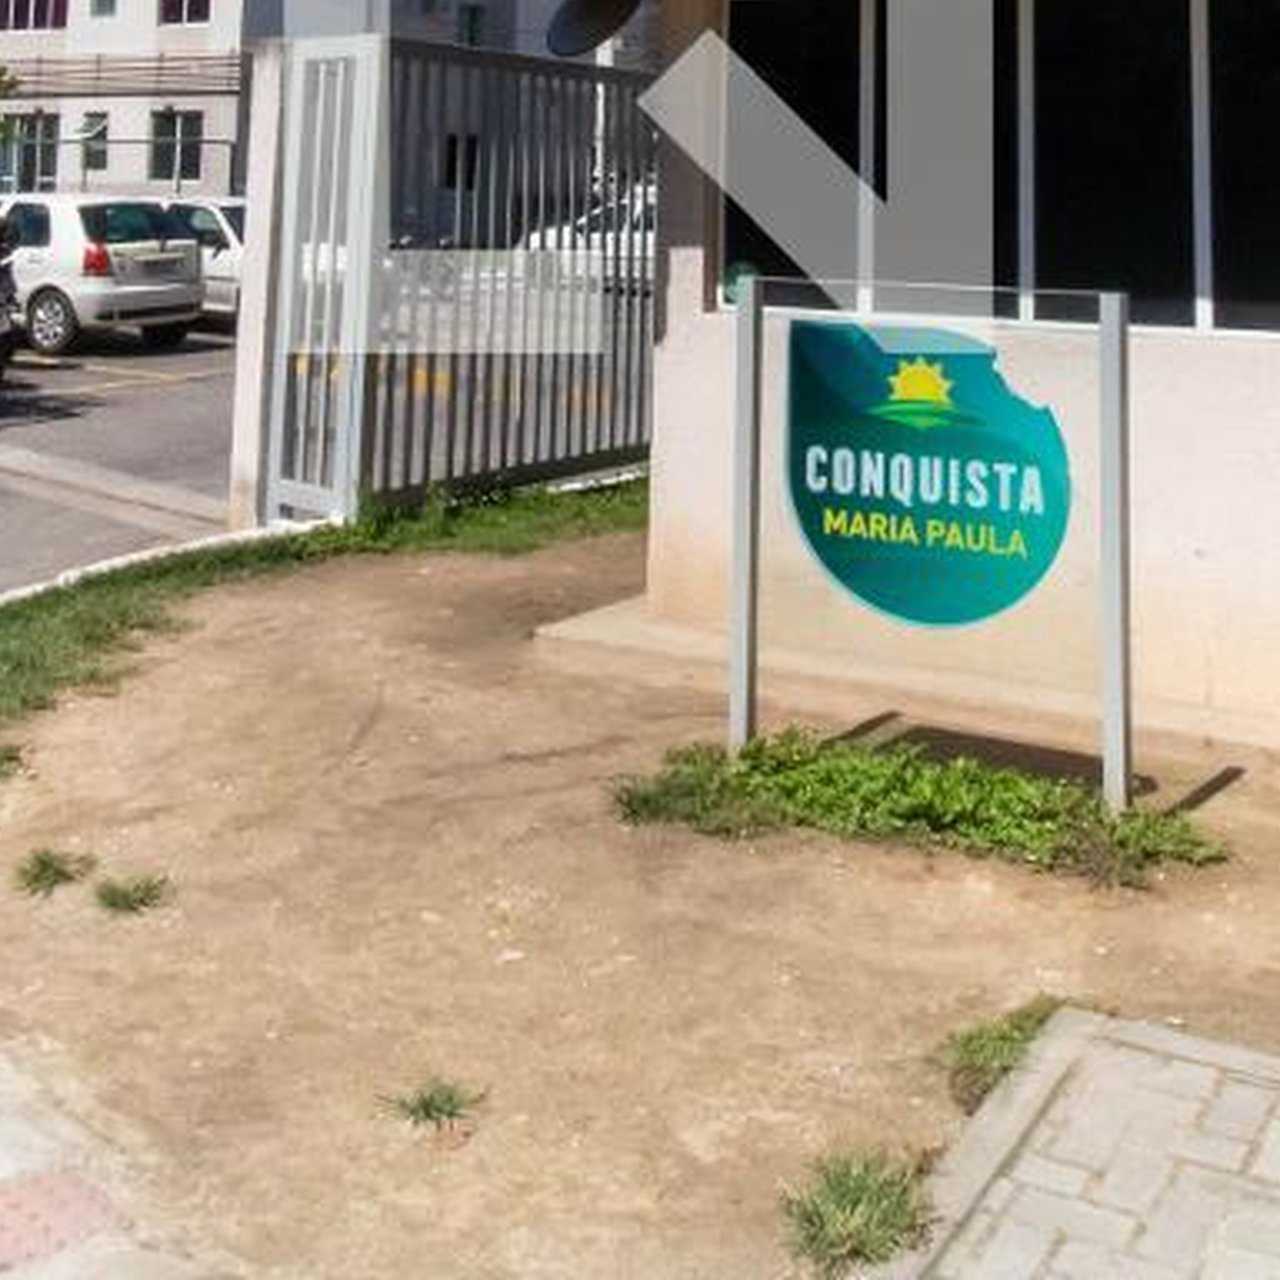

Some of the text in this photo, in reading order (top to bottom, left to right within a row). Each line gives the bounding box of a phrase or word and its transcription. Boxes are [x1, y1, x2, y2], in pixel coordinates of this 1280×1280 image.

[804, 445, 1046, 516] CONQUISTA
[822, 508, 1027, 558] MARIA PAULA
